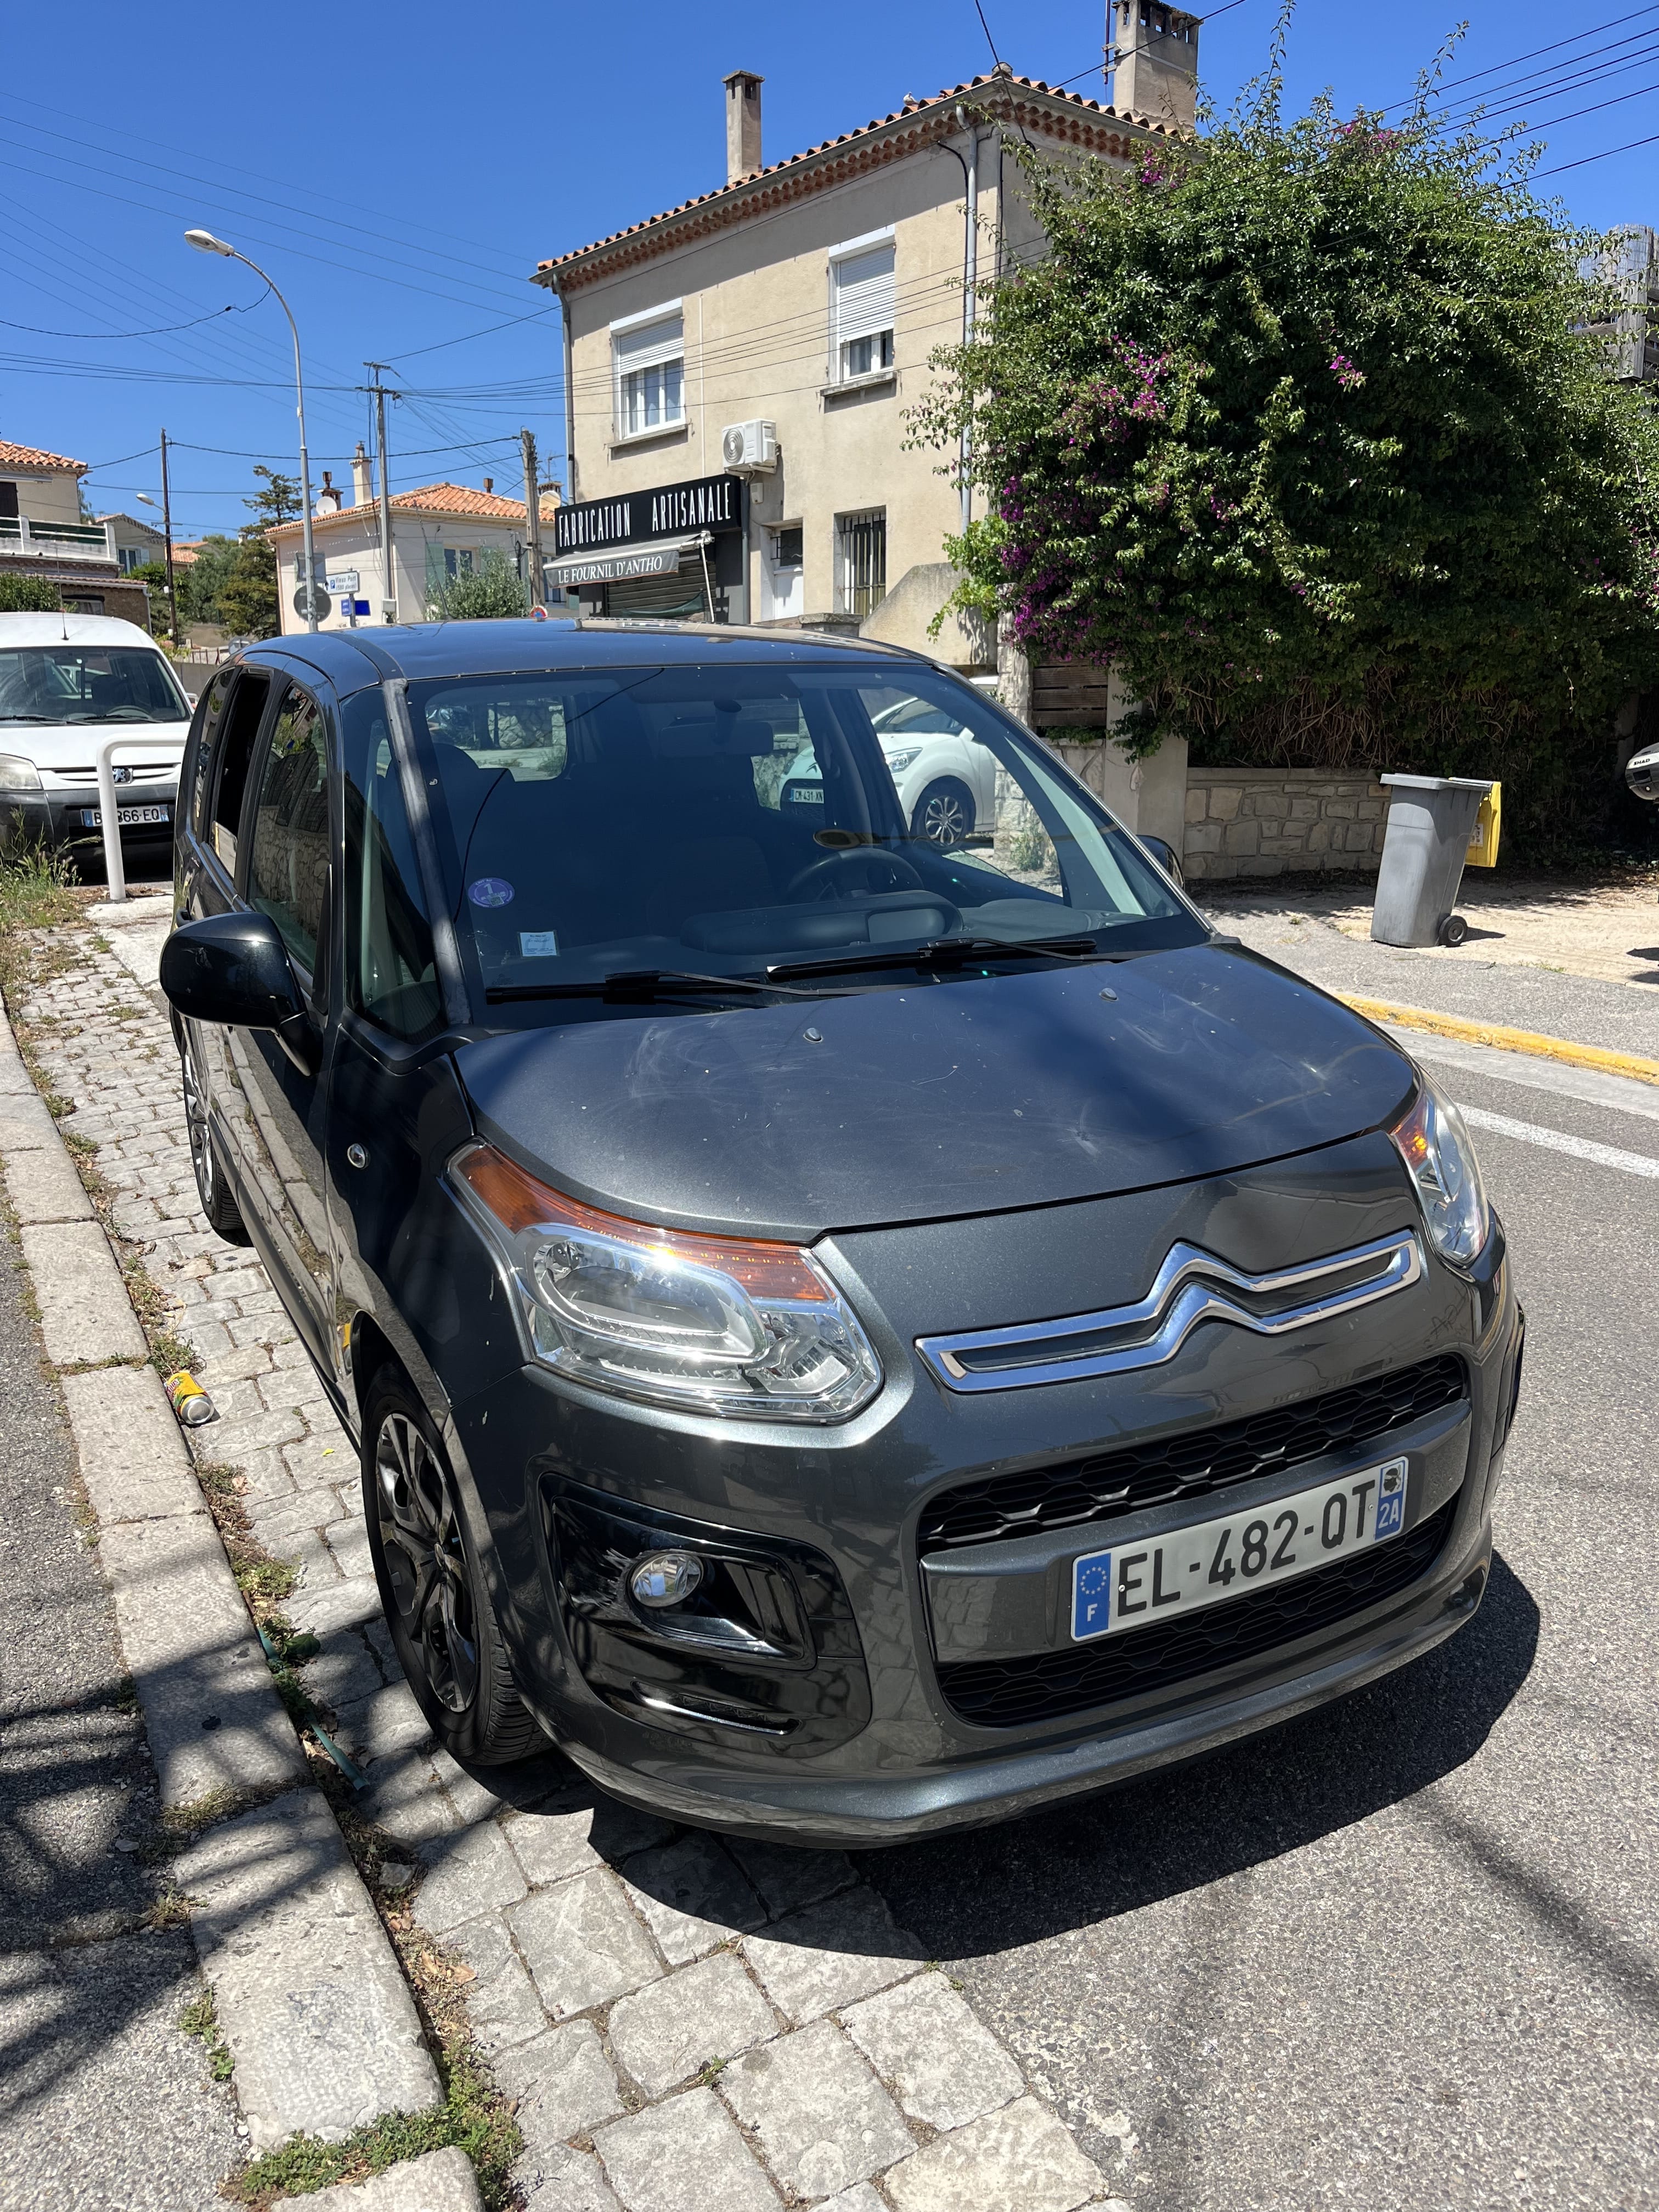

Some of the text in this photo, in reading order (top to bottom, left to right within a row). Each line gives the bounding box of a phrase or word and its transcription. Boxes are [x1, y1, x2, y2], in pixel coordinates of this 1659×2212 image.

[559, 482, 731, 548] FABRICATION ARTISANALE
[558, 556, 663, 584] LE FOURNIL D'ANTHO
[484, 883, 493, 894] 1
[1378, 1502, 1399, 1529] 2A
[1117, 1479, 1375, 1617] EL-482-QT
[1087, 1603, 1098, 1622] F
